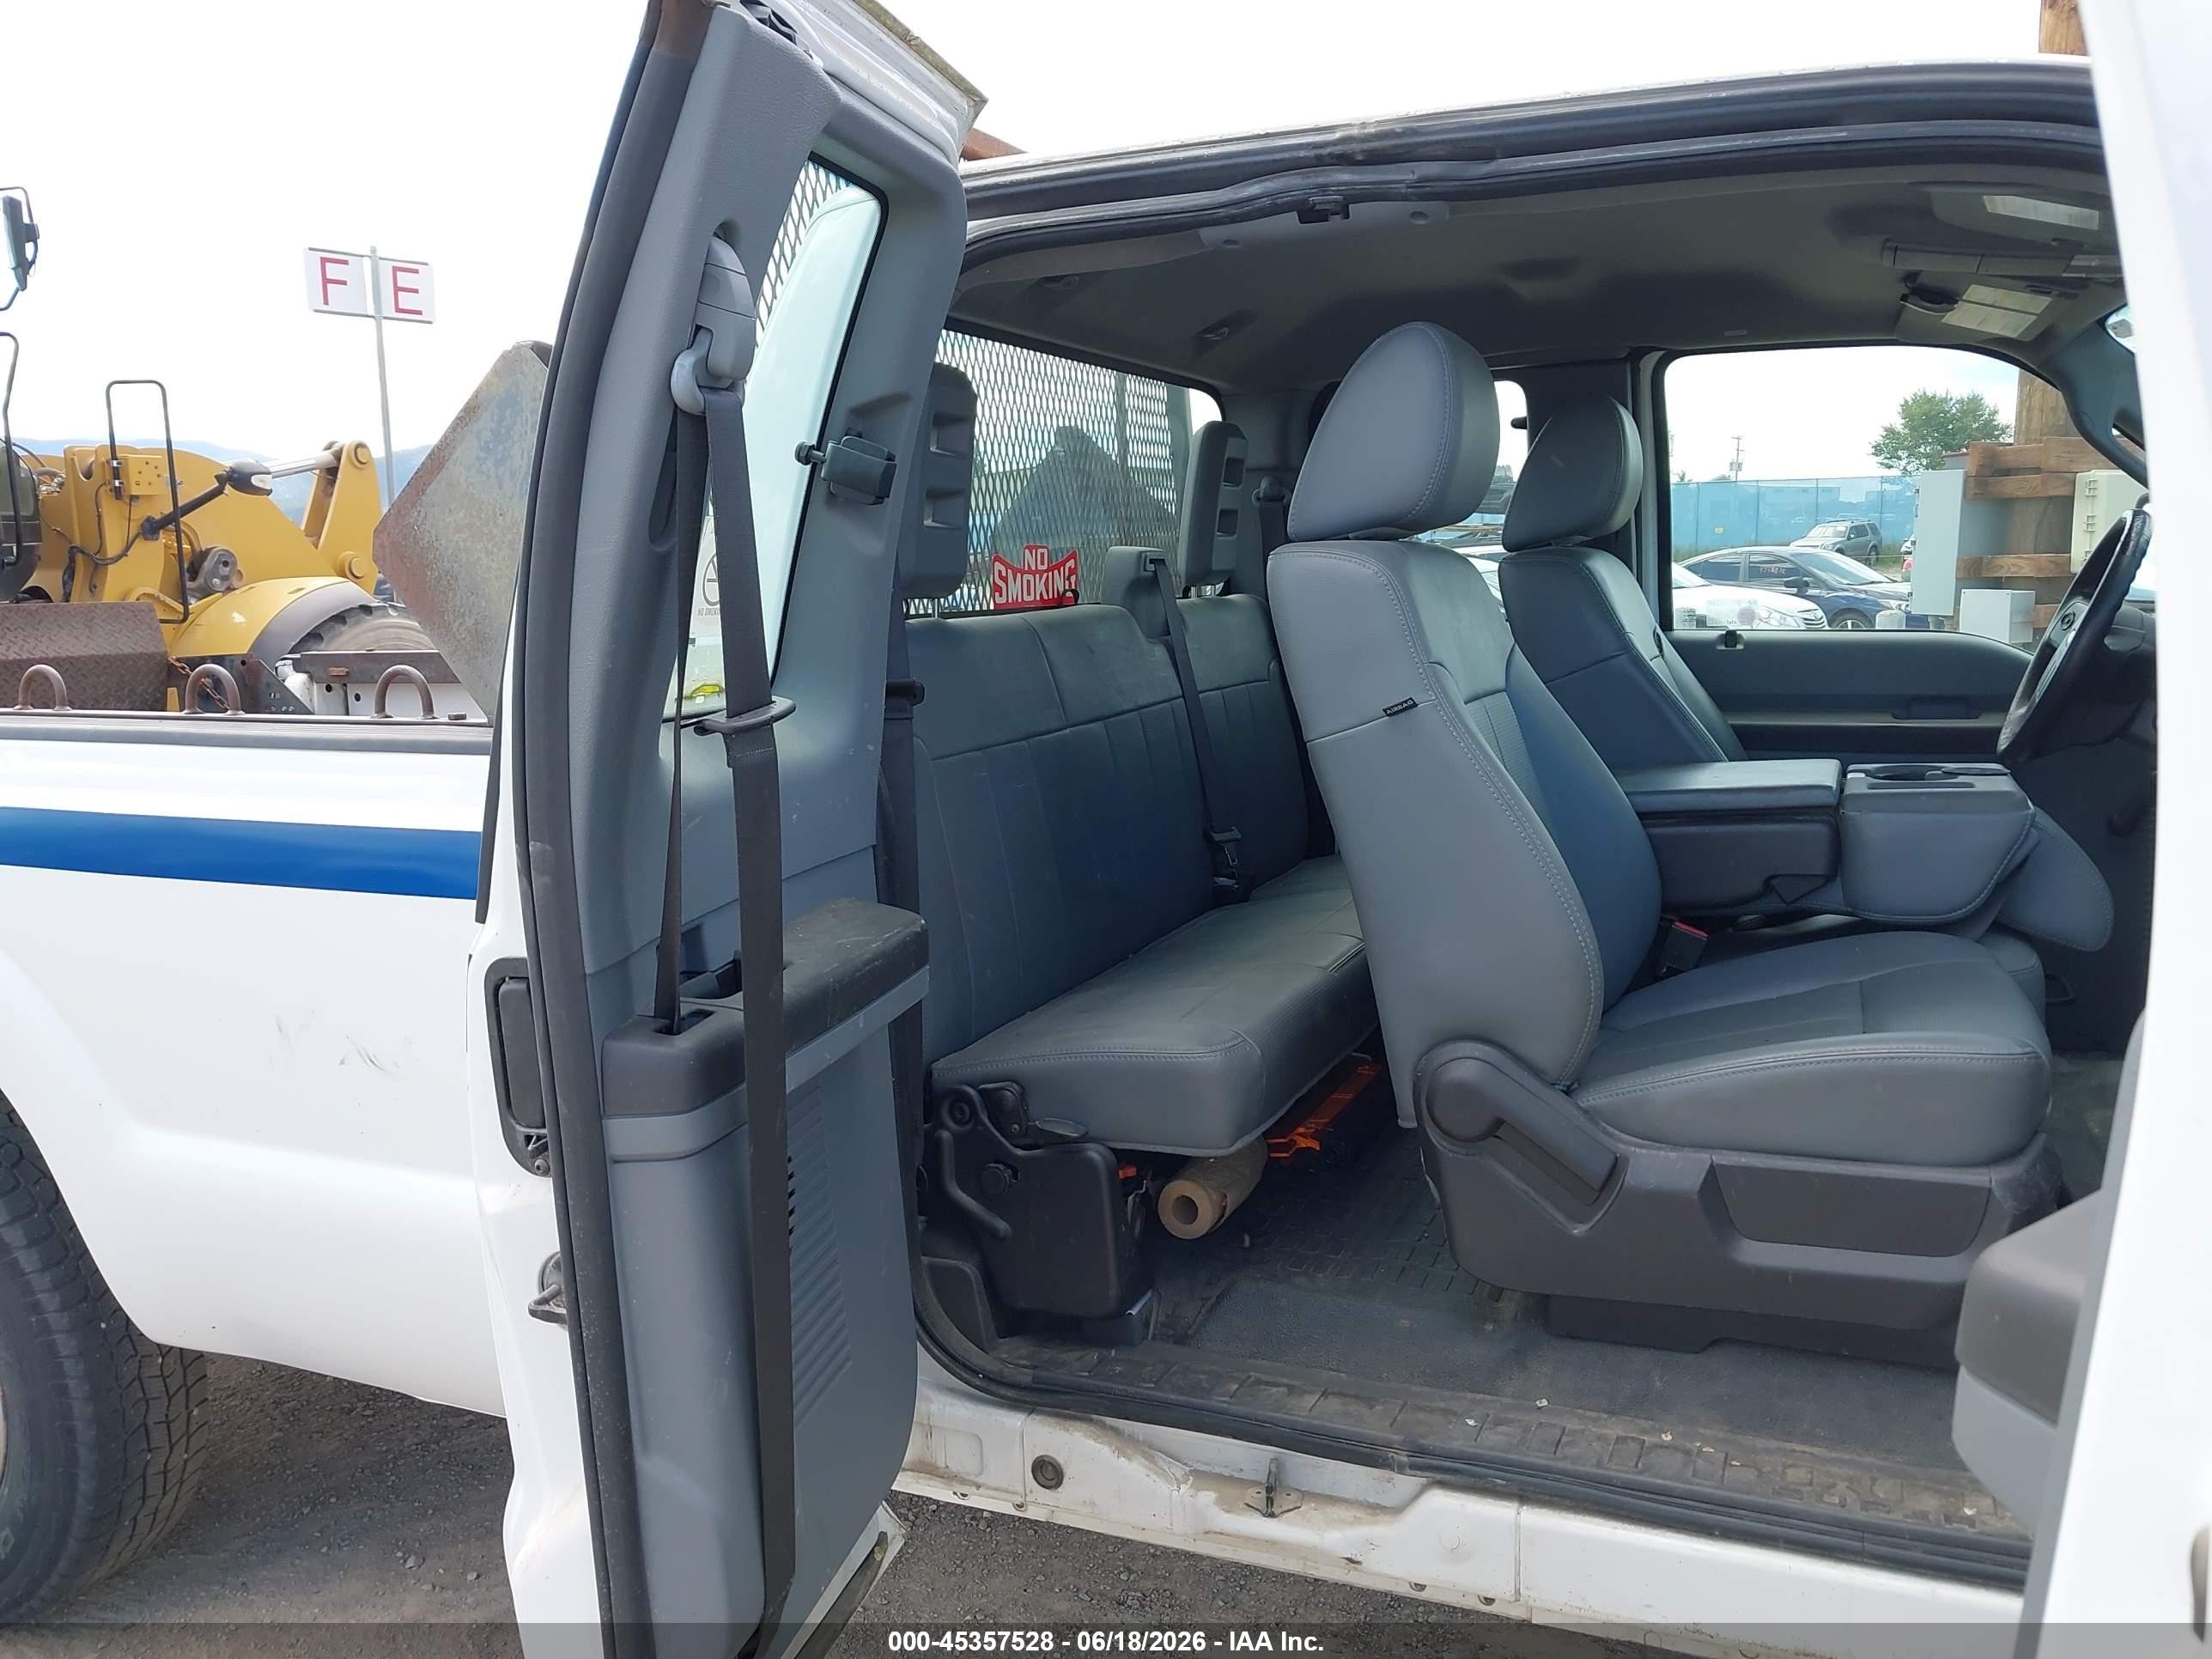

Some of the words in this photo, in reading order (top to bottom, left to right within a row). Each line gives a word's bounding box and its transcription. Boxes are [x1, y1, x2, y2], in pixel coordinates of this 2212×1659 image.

[319, 256, 349, 306] F
[392, 265, 422, 316] E
[1024, 548, 1048, 571] NO
[994, 558, 1077, 605] SMOKING
[1386, 699, 1414, 714] AIRBAG
